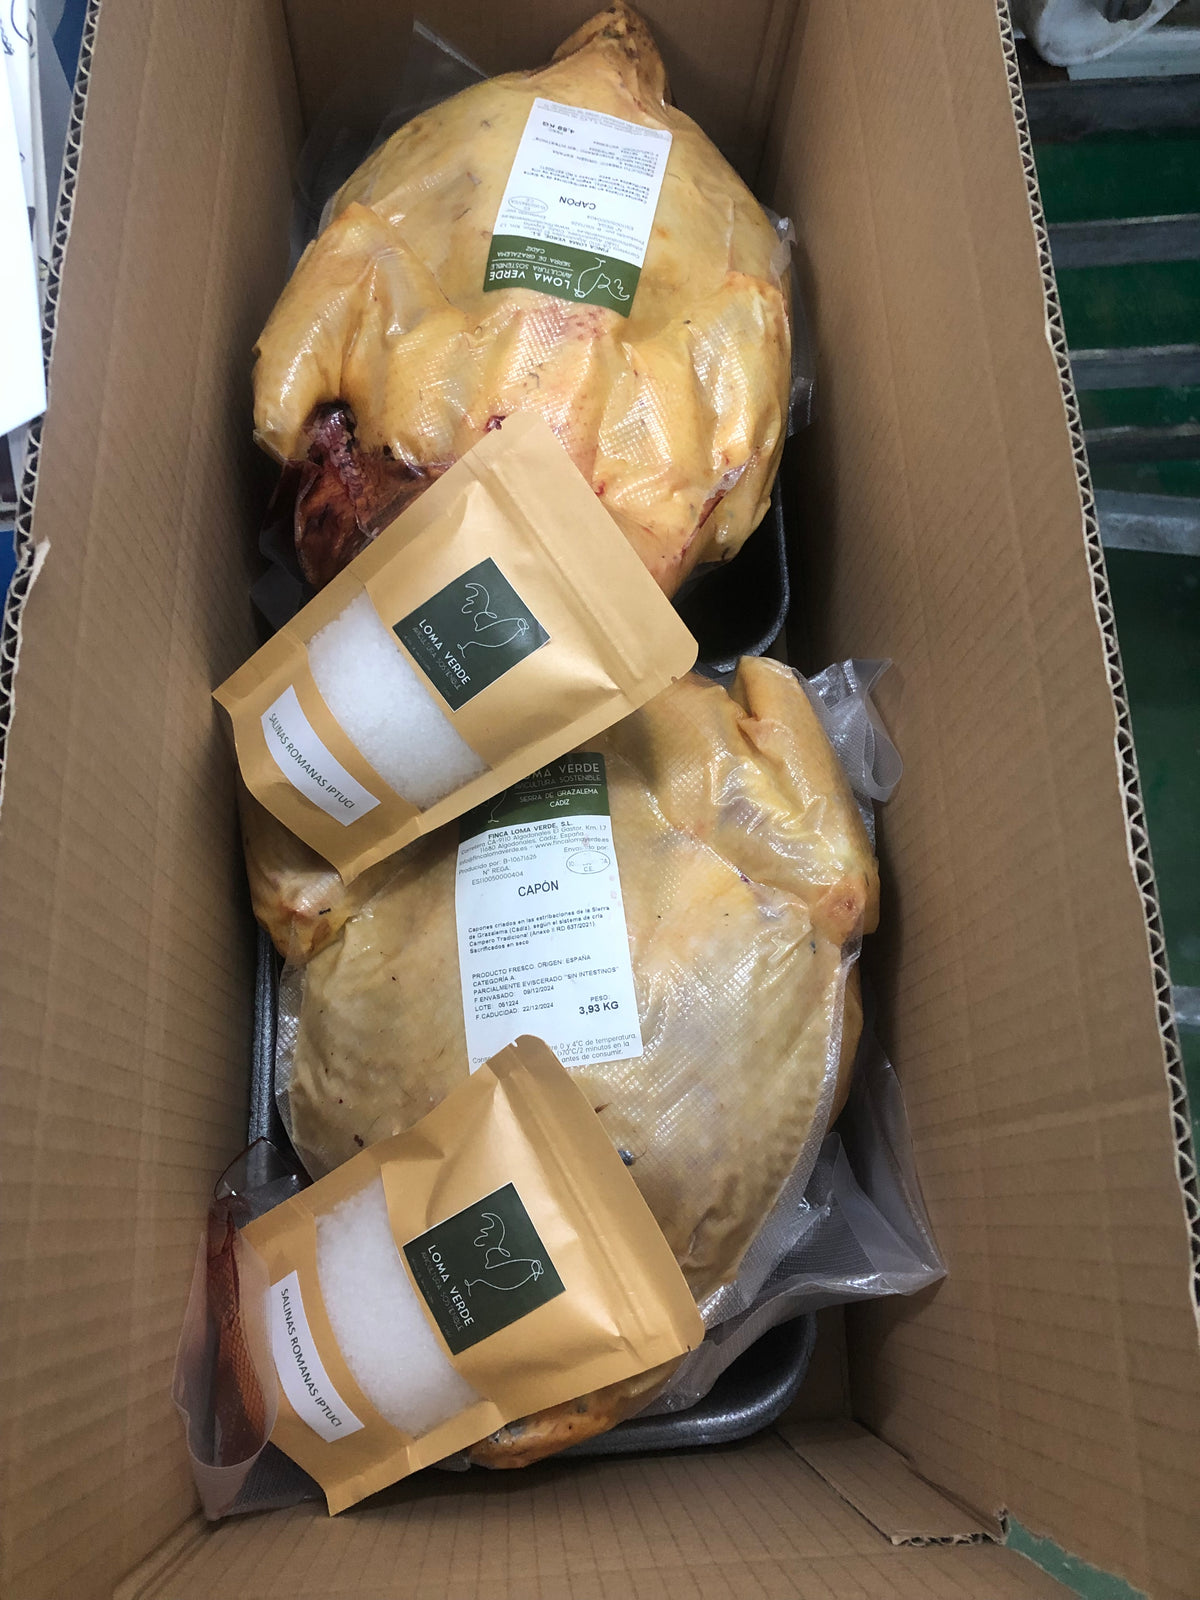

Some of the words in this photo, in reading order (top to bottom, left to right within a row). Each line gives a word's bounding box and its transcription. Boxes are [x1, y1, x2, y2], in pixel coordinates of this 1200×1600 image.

[558, 195, 596, 210] CAPÓN
[496, 251, 535, 259] GRAZALEMA
[525, 244, 545, 255] CÁDIZ
[548, 257, 571, 268] SIERRA
[488, 270, 525, 280] VERDE
[531, 264, 572, 279] AVICULTURA
[532, 272, 570, 289] LOMA
[418, 618, 445, 650] LOMA
[441, 650, 471, 685] VERDE
[268, 712, 288, 745] SALINAS
[285, 742, 328, 786] ROMANAS
[325, 784, 355, 809] IPTUCI
[559, 763, 599, 773] VERDE
[559, 775, 601, 783] SOSTENIBLE
[519, 794, 541, 802] SIERRA
[556, 787, 598, 796] GRAZALEMA
[549, 797, 570, 807] CÁDIZ
[487, 830, 508, 838] FINCA
[511, 826, 530, 834] LOMA
[512, 828, 551, 840] Algodonales
[516, 878, 559, 896] CAPÓN
[468, 924, 492, 933] Capones
[535, 910, 574, 920] estribaciones
[476, 928, 507, 938] Grazalema
[558, 916, 581, 924] sistema
[468, 937, 495, 947] Campero
[469, 943, 504, 953] Sacrificados
[471, 968, 507, 979] PRODUCTO
[565, 954, 591, 963] ESPAÑA
[472, 975, 508, 987] CATEGORÍA
[472, 982, 520, 994] PARCIALMENTE
[522, 975, 562, 986] EVISCERADO
[522, 1002, 553, 1011] 22/12/2024
[578, 1003, 600, 1015] 3,93
[602, 1000, 618, 1011] KG
[585, 1043, 611, 1052] minutos
[427, 1244, 450, 1282] LOMA
[447, 1286, 474, 1326] VERDE
[280, 1288, 296, 1335] SALINAS
[289, 1336, 318, 1396] ROMANAS
[314, 1396, 342, 1426] IPTUCI
